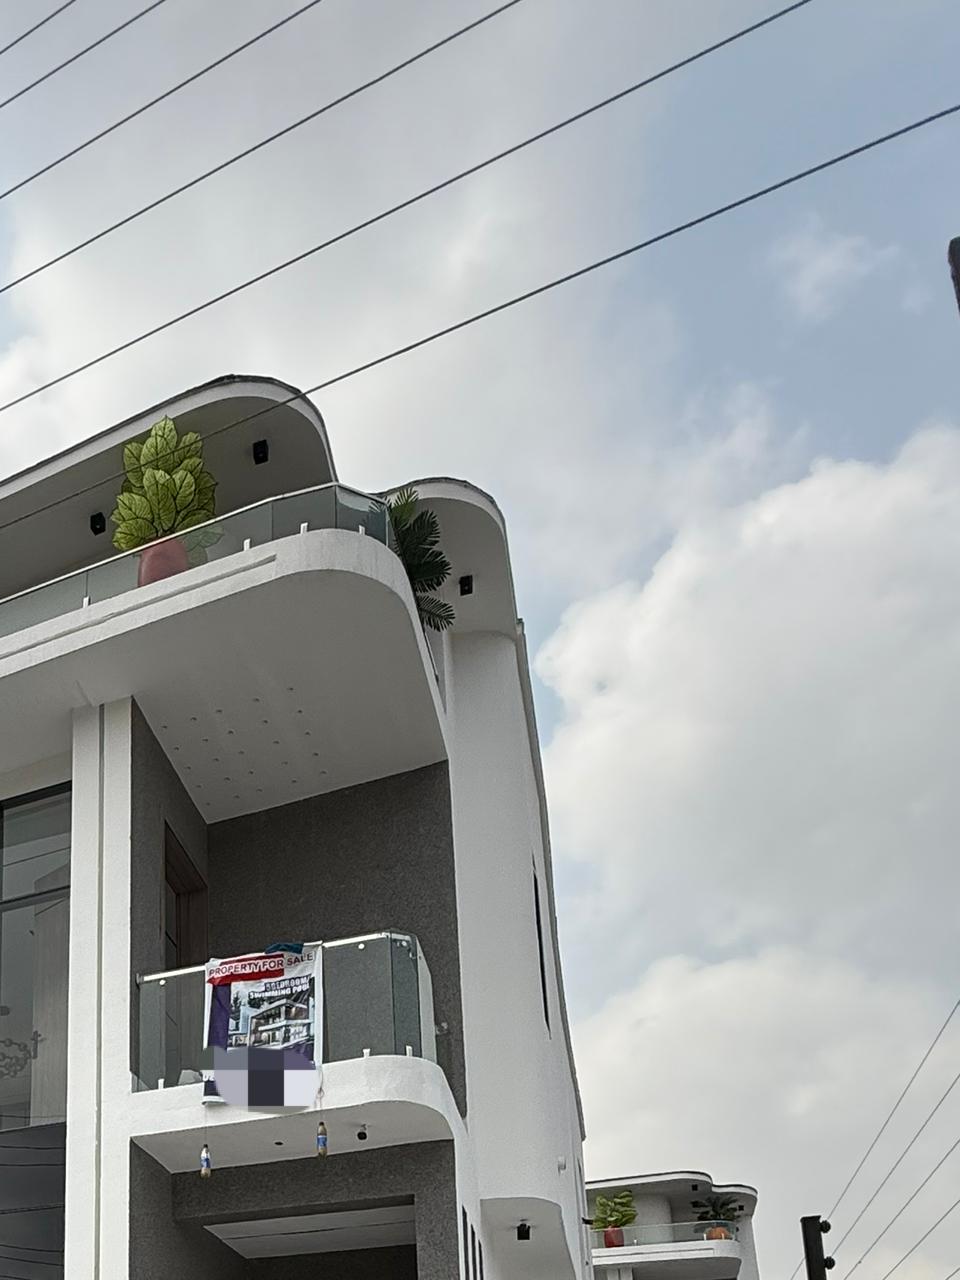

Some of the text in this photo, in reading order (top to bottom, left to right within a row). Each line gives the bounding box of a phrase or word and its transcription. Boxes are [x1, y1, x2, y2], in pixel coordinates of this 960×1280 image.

[208, 953, 313, 977] PROPERTY FOR SALE
[249, 984, 310, 999] SWIMMING POOL
